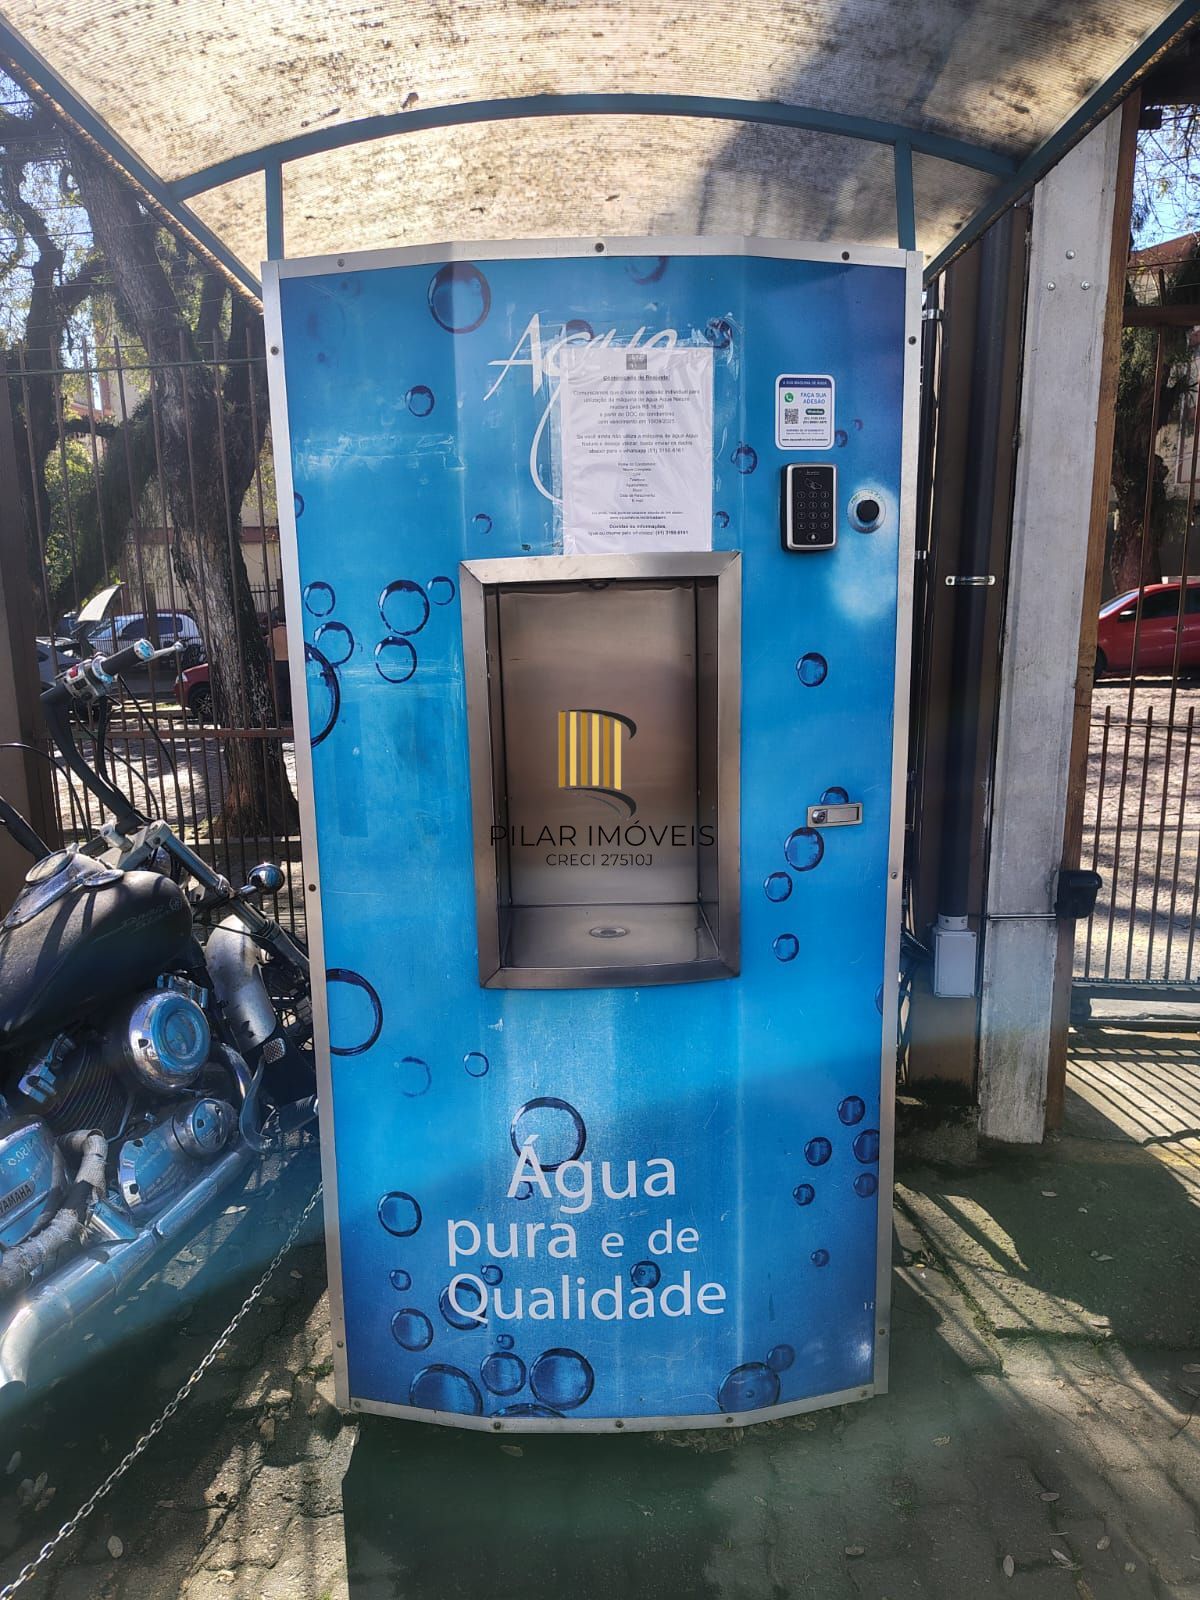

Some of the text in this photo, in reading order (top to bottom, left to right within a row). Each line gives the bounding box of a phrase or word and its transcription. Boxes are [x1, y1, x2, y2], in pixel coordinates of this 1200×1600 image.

[507, 1134, 677, 1214] Água
[447, 1219, 700, 1267] pura e de
[448, 1270, 727, 1323] Qualidade
